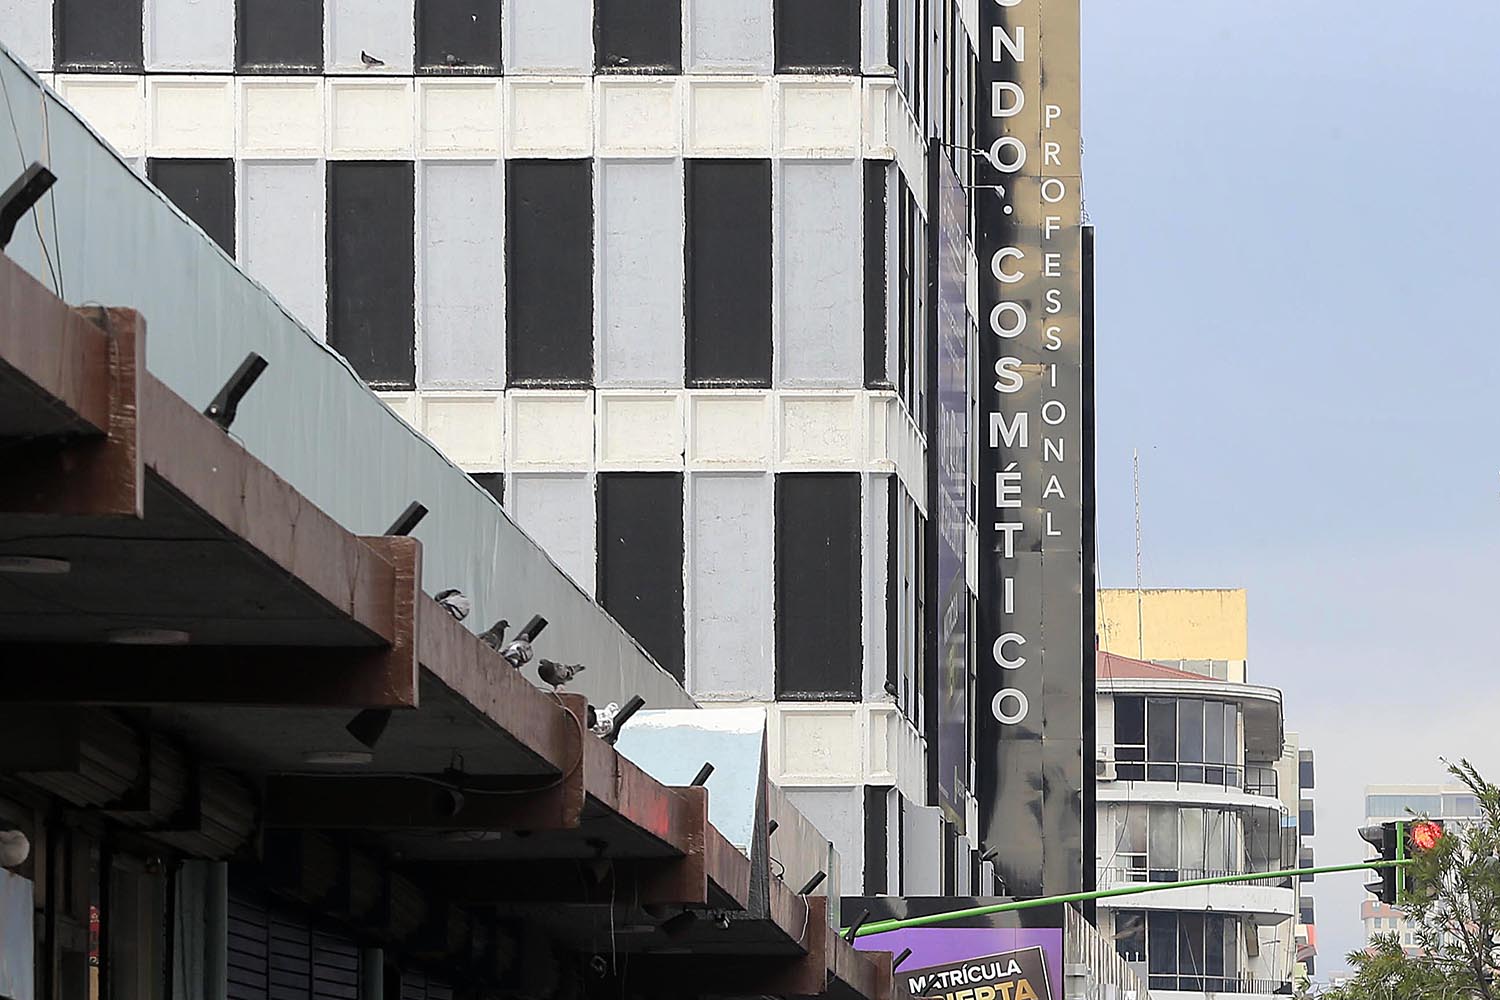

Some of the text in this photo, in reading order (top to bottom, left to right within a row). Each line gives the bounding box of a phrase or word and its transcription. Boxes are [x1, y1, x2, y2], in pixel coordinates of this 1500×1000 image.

[990, 0, 1026, 174] NDO
[1042, 104, 1067, 537] PROFESSIONAL
[989, 246, 1029, 726] COSMÉTICO
[908, 958, 1023, 994] MATRÍCULA
